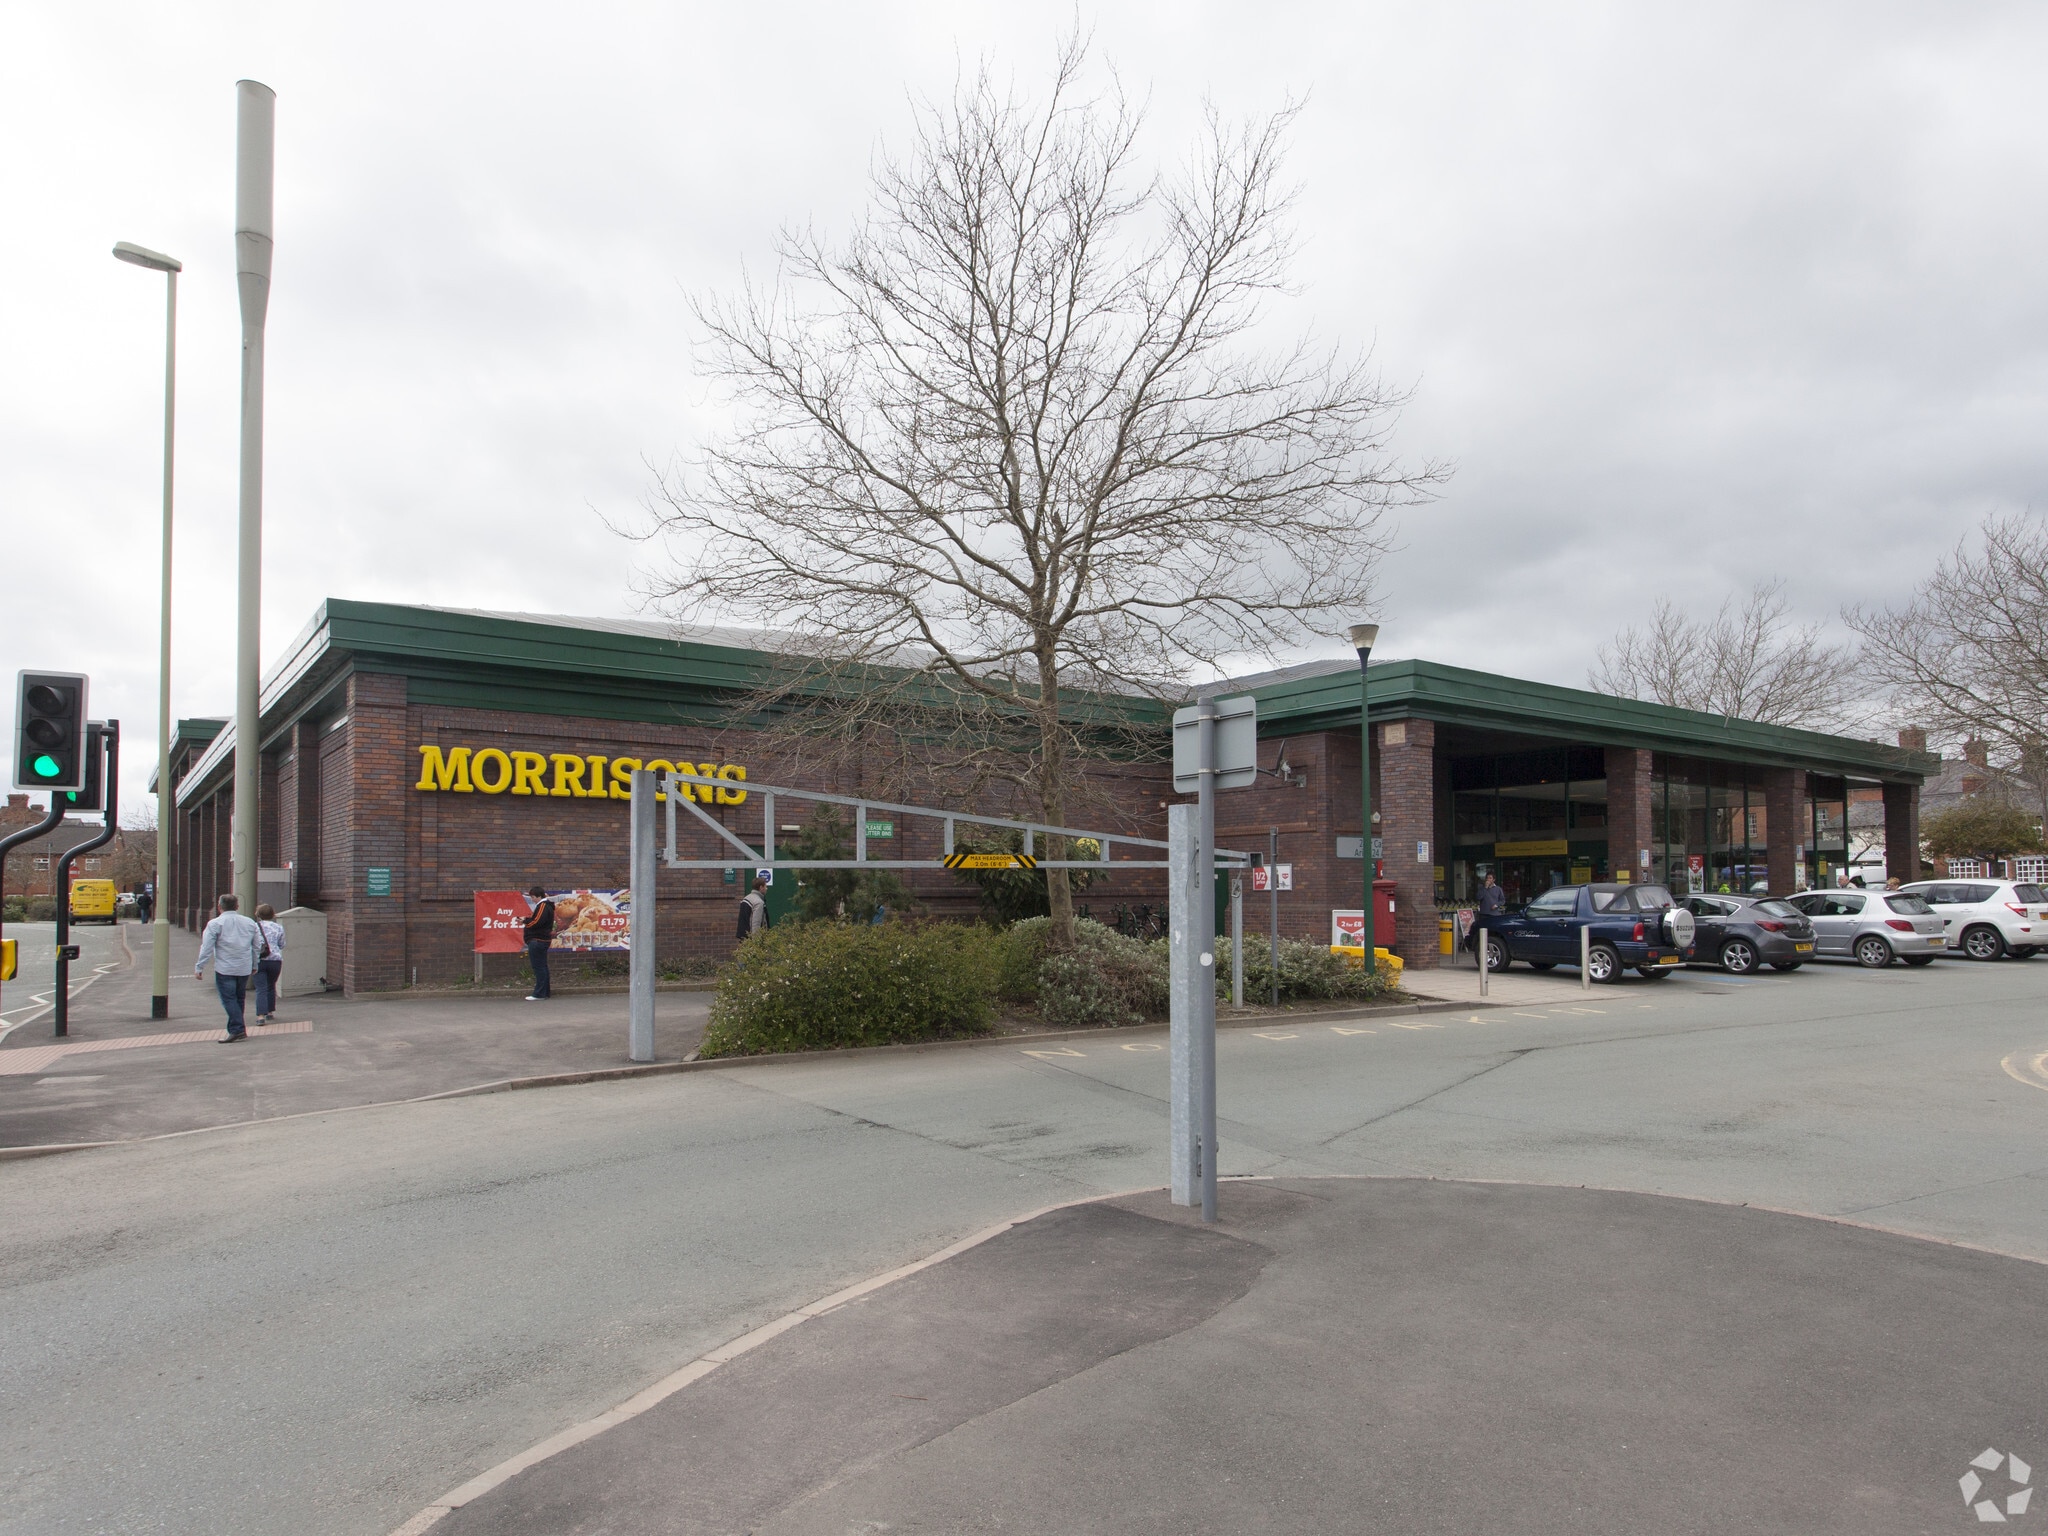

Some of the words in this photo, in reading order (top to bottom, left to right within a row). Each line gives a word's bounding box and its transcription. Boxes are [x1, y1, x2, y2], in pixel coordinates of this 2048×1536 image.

[1255, 872, 1266, 881] 1/2
[497, 908, 513, 917] Any
[482, 917, 492, 929] 2
[493, 919, 509, 929] for
[601, 918, 625, 926] £1.79
